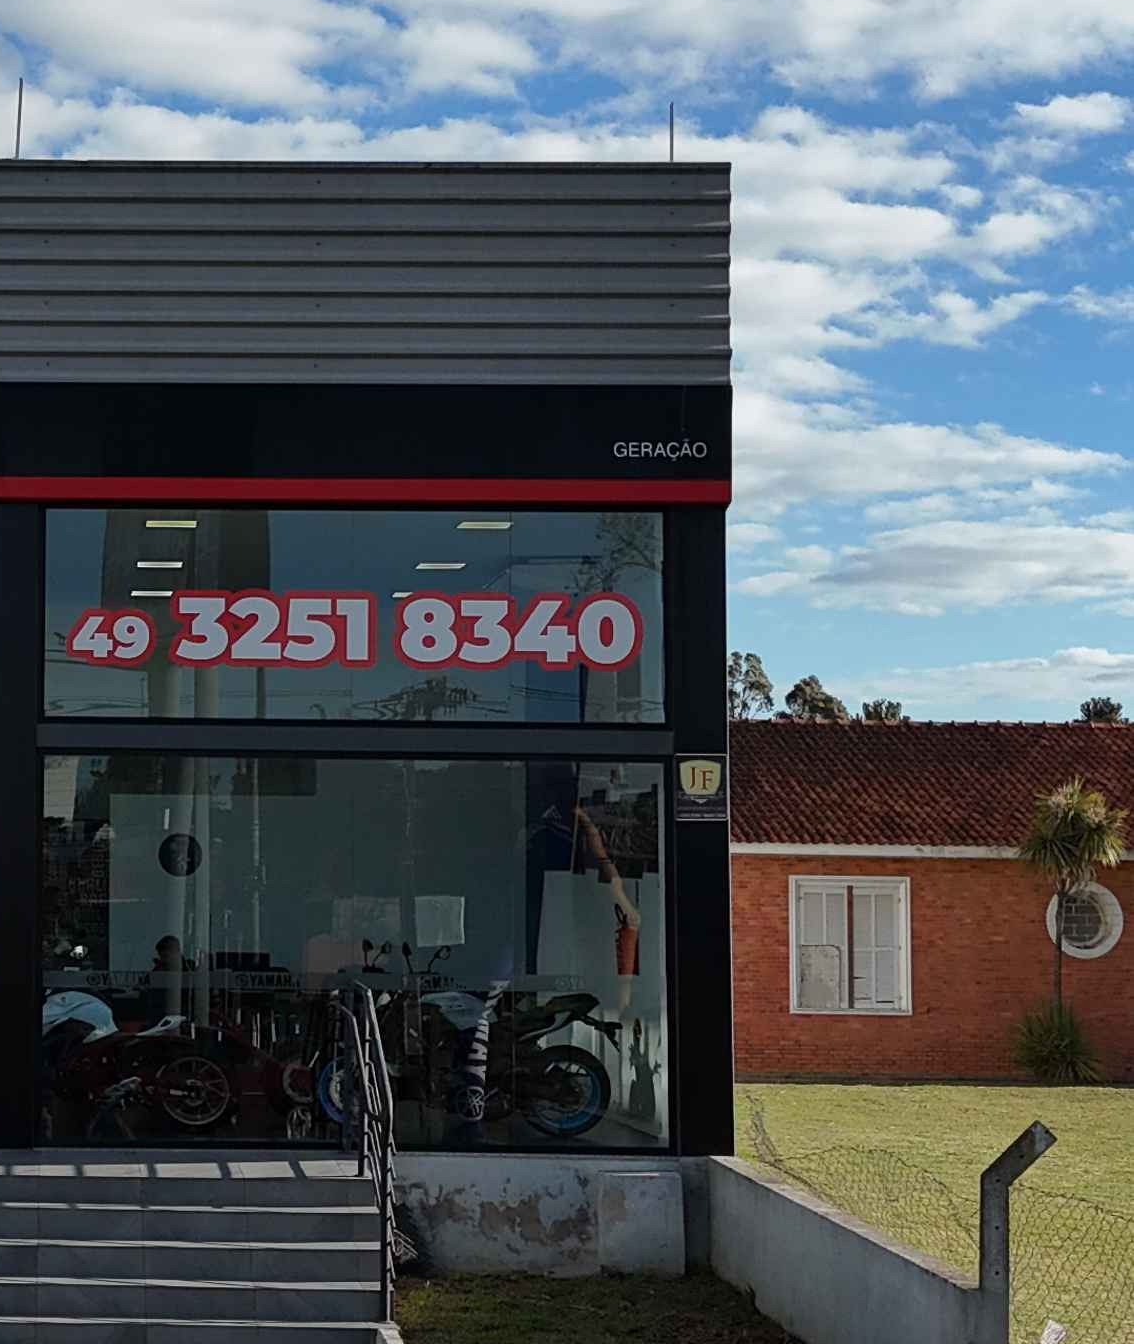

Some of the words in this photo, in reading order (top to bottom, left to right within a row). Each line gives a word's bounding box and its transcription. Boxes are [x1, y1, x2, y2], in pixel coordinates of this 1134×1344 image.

[613, 437, 708, 461] GERAÇÃO
[69, 613, 153, 661] 49
[174, 596, 372, 664] 3251
[398, 596, 637, 666] 8340
[689, 767, 715, 790] JF
